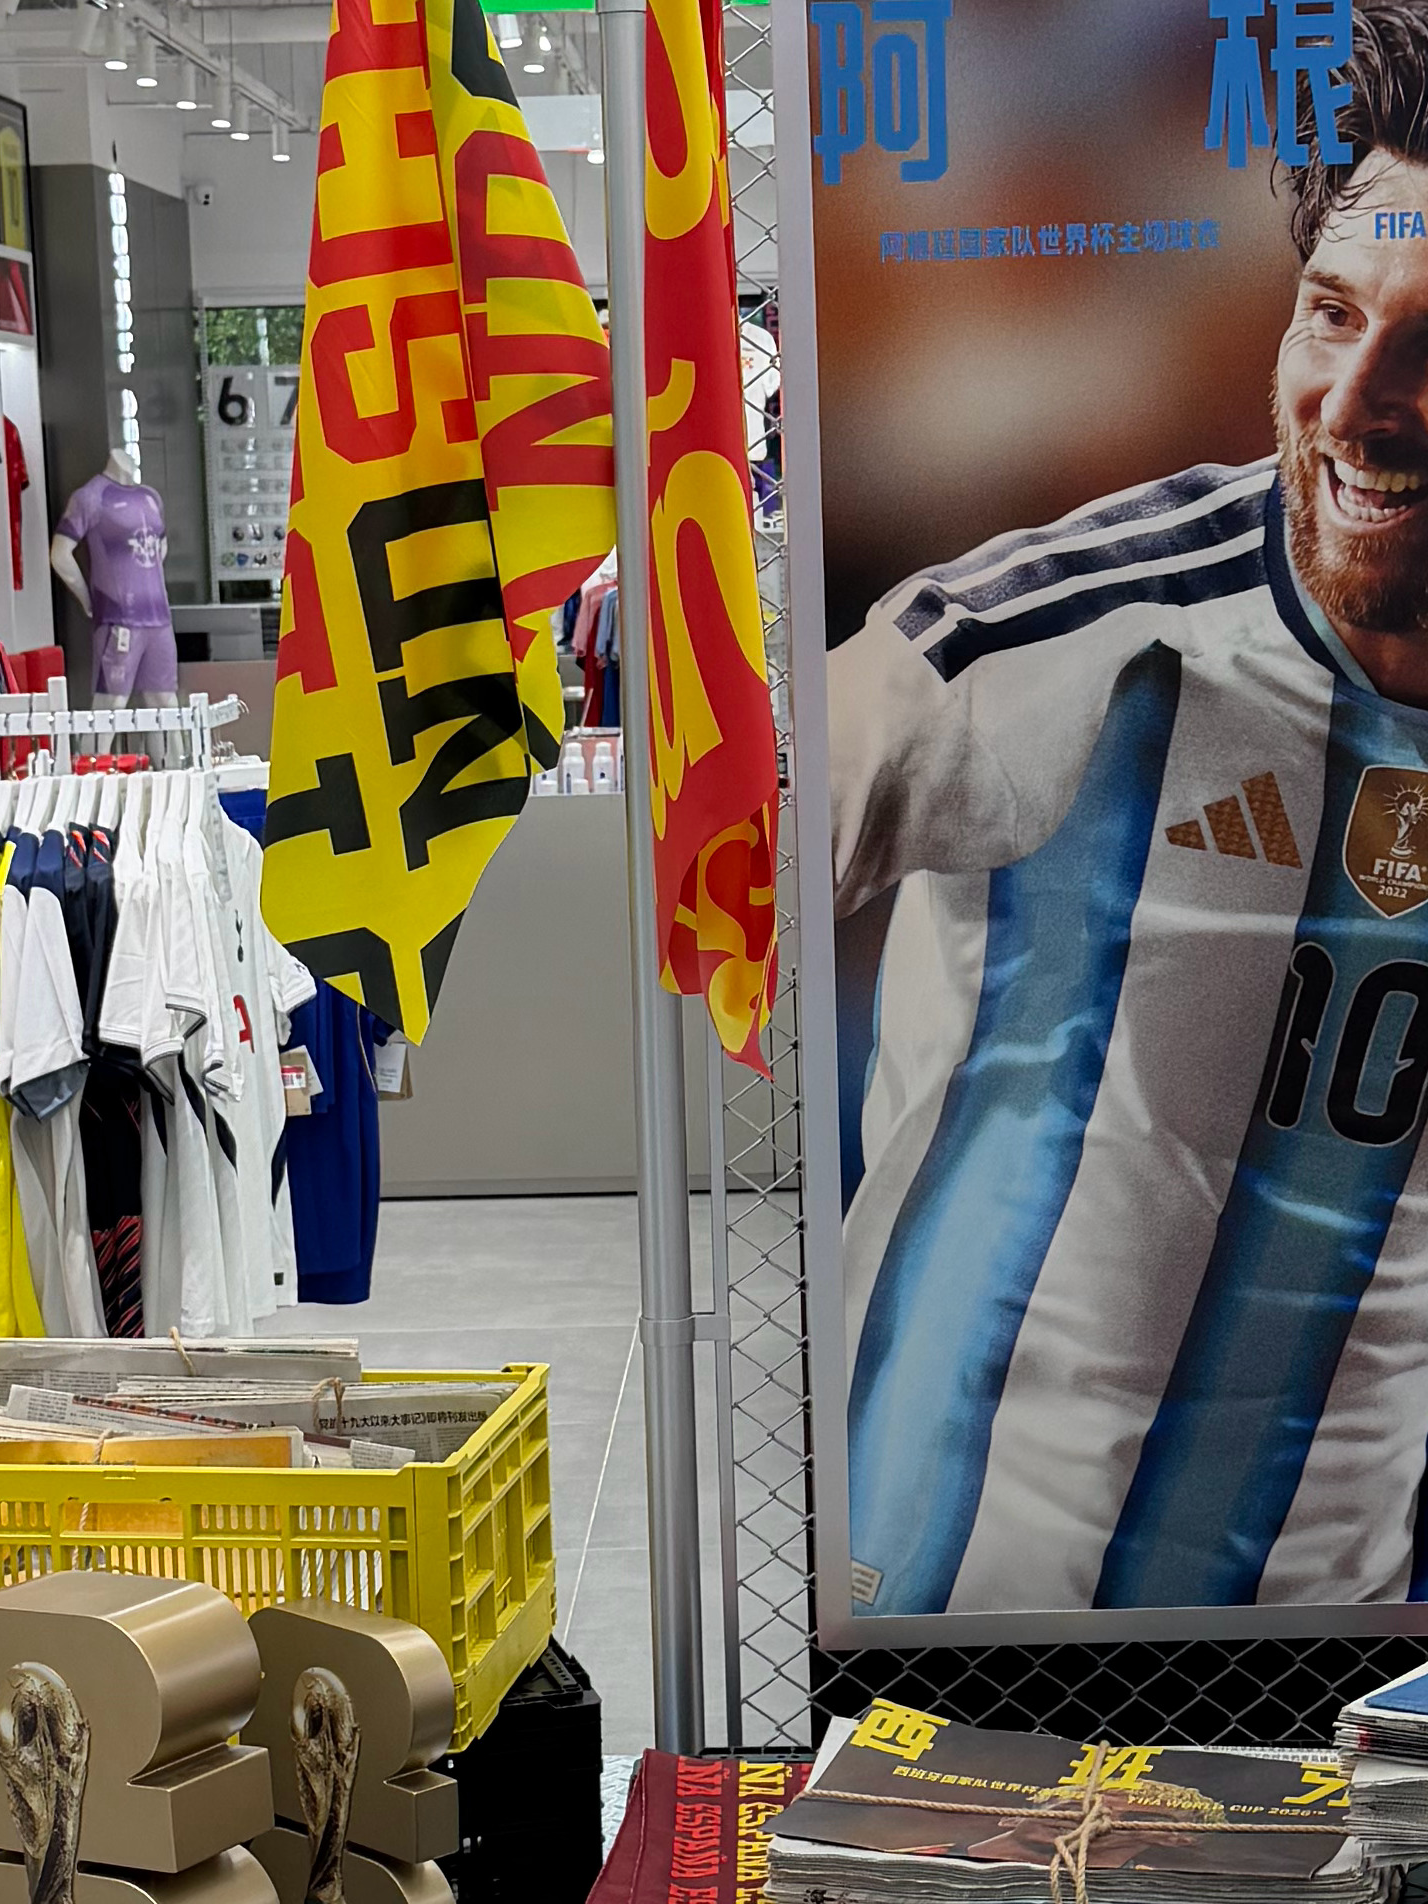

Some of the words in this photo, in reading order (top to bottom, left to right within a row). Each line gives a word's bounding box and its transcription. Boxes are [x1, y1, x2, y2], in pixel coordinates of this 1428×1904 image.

[1373, 211, 1427, 240] FIFA
[218, 375, 248, 426] 6
[1378, 884, 1408, 899] 2022
[1228, 1804, 1264, 1815] CUP
